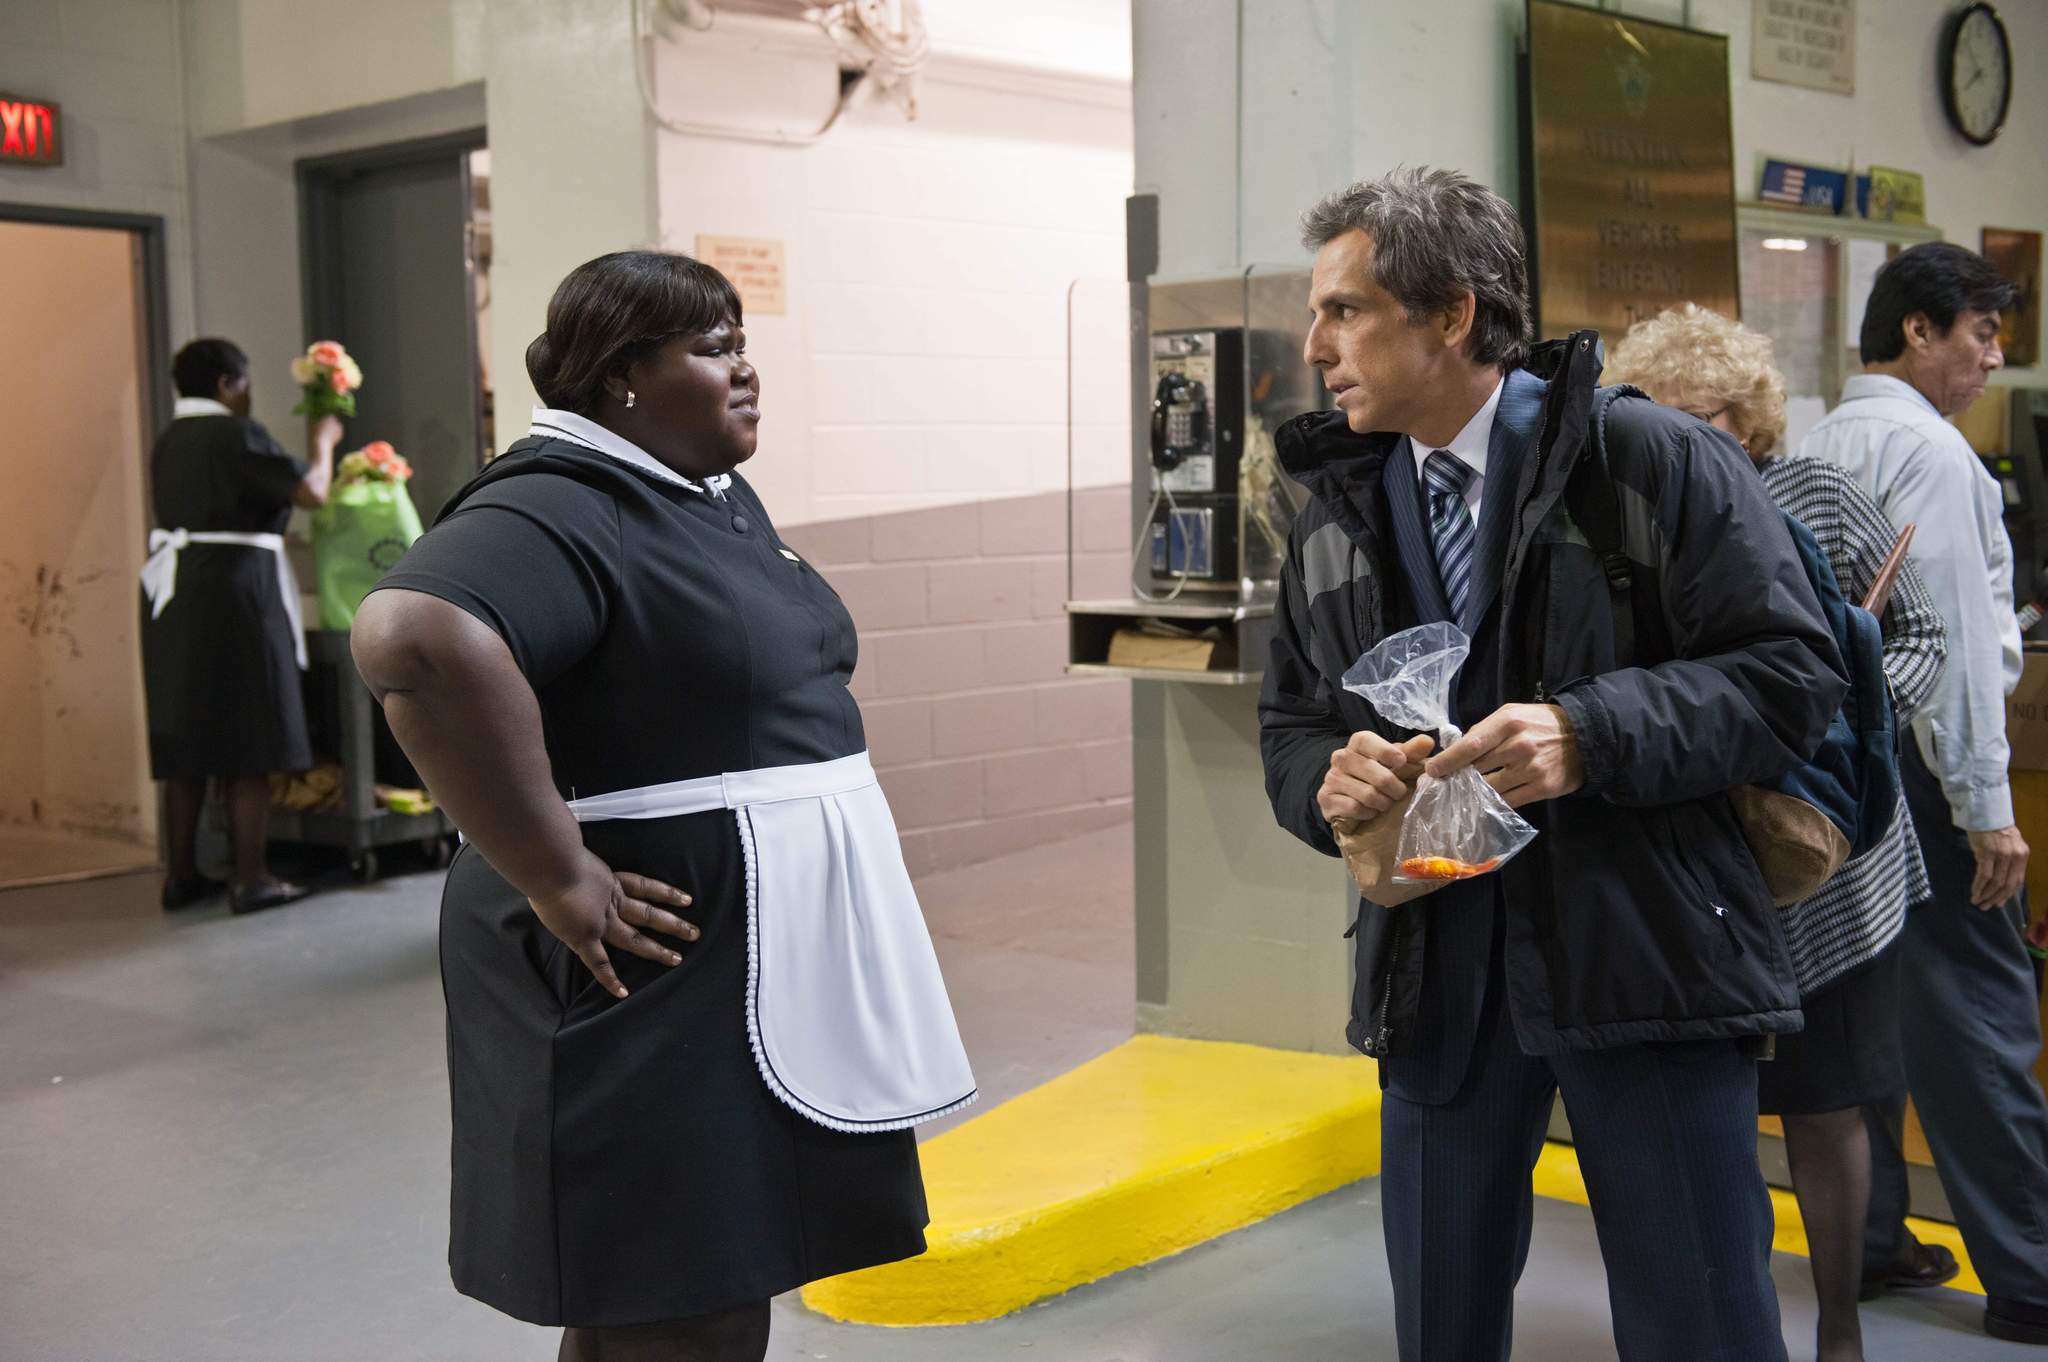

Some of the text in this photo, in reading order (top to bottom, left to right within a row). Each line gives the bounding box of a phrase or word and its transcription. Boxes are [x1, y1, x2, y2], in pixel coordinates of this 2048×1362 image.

[1623, 177, 1655, 209] ALL
[1599, 218, 1680, 252] VEHICLES
[1598, 261, 1684, 294] ENTERING
[2013, 703, 2037, 720] NO
